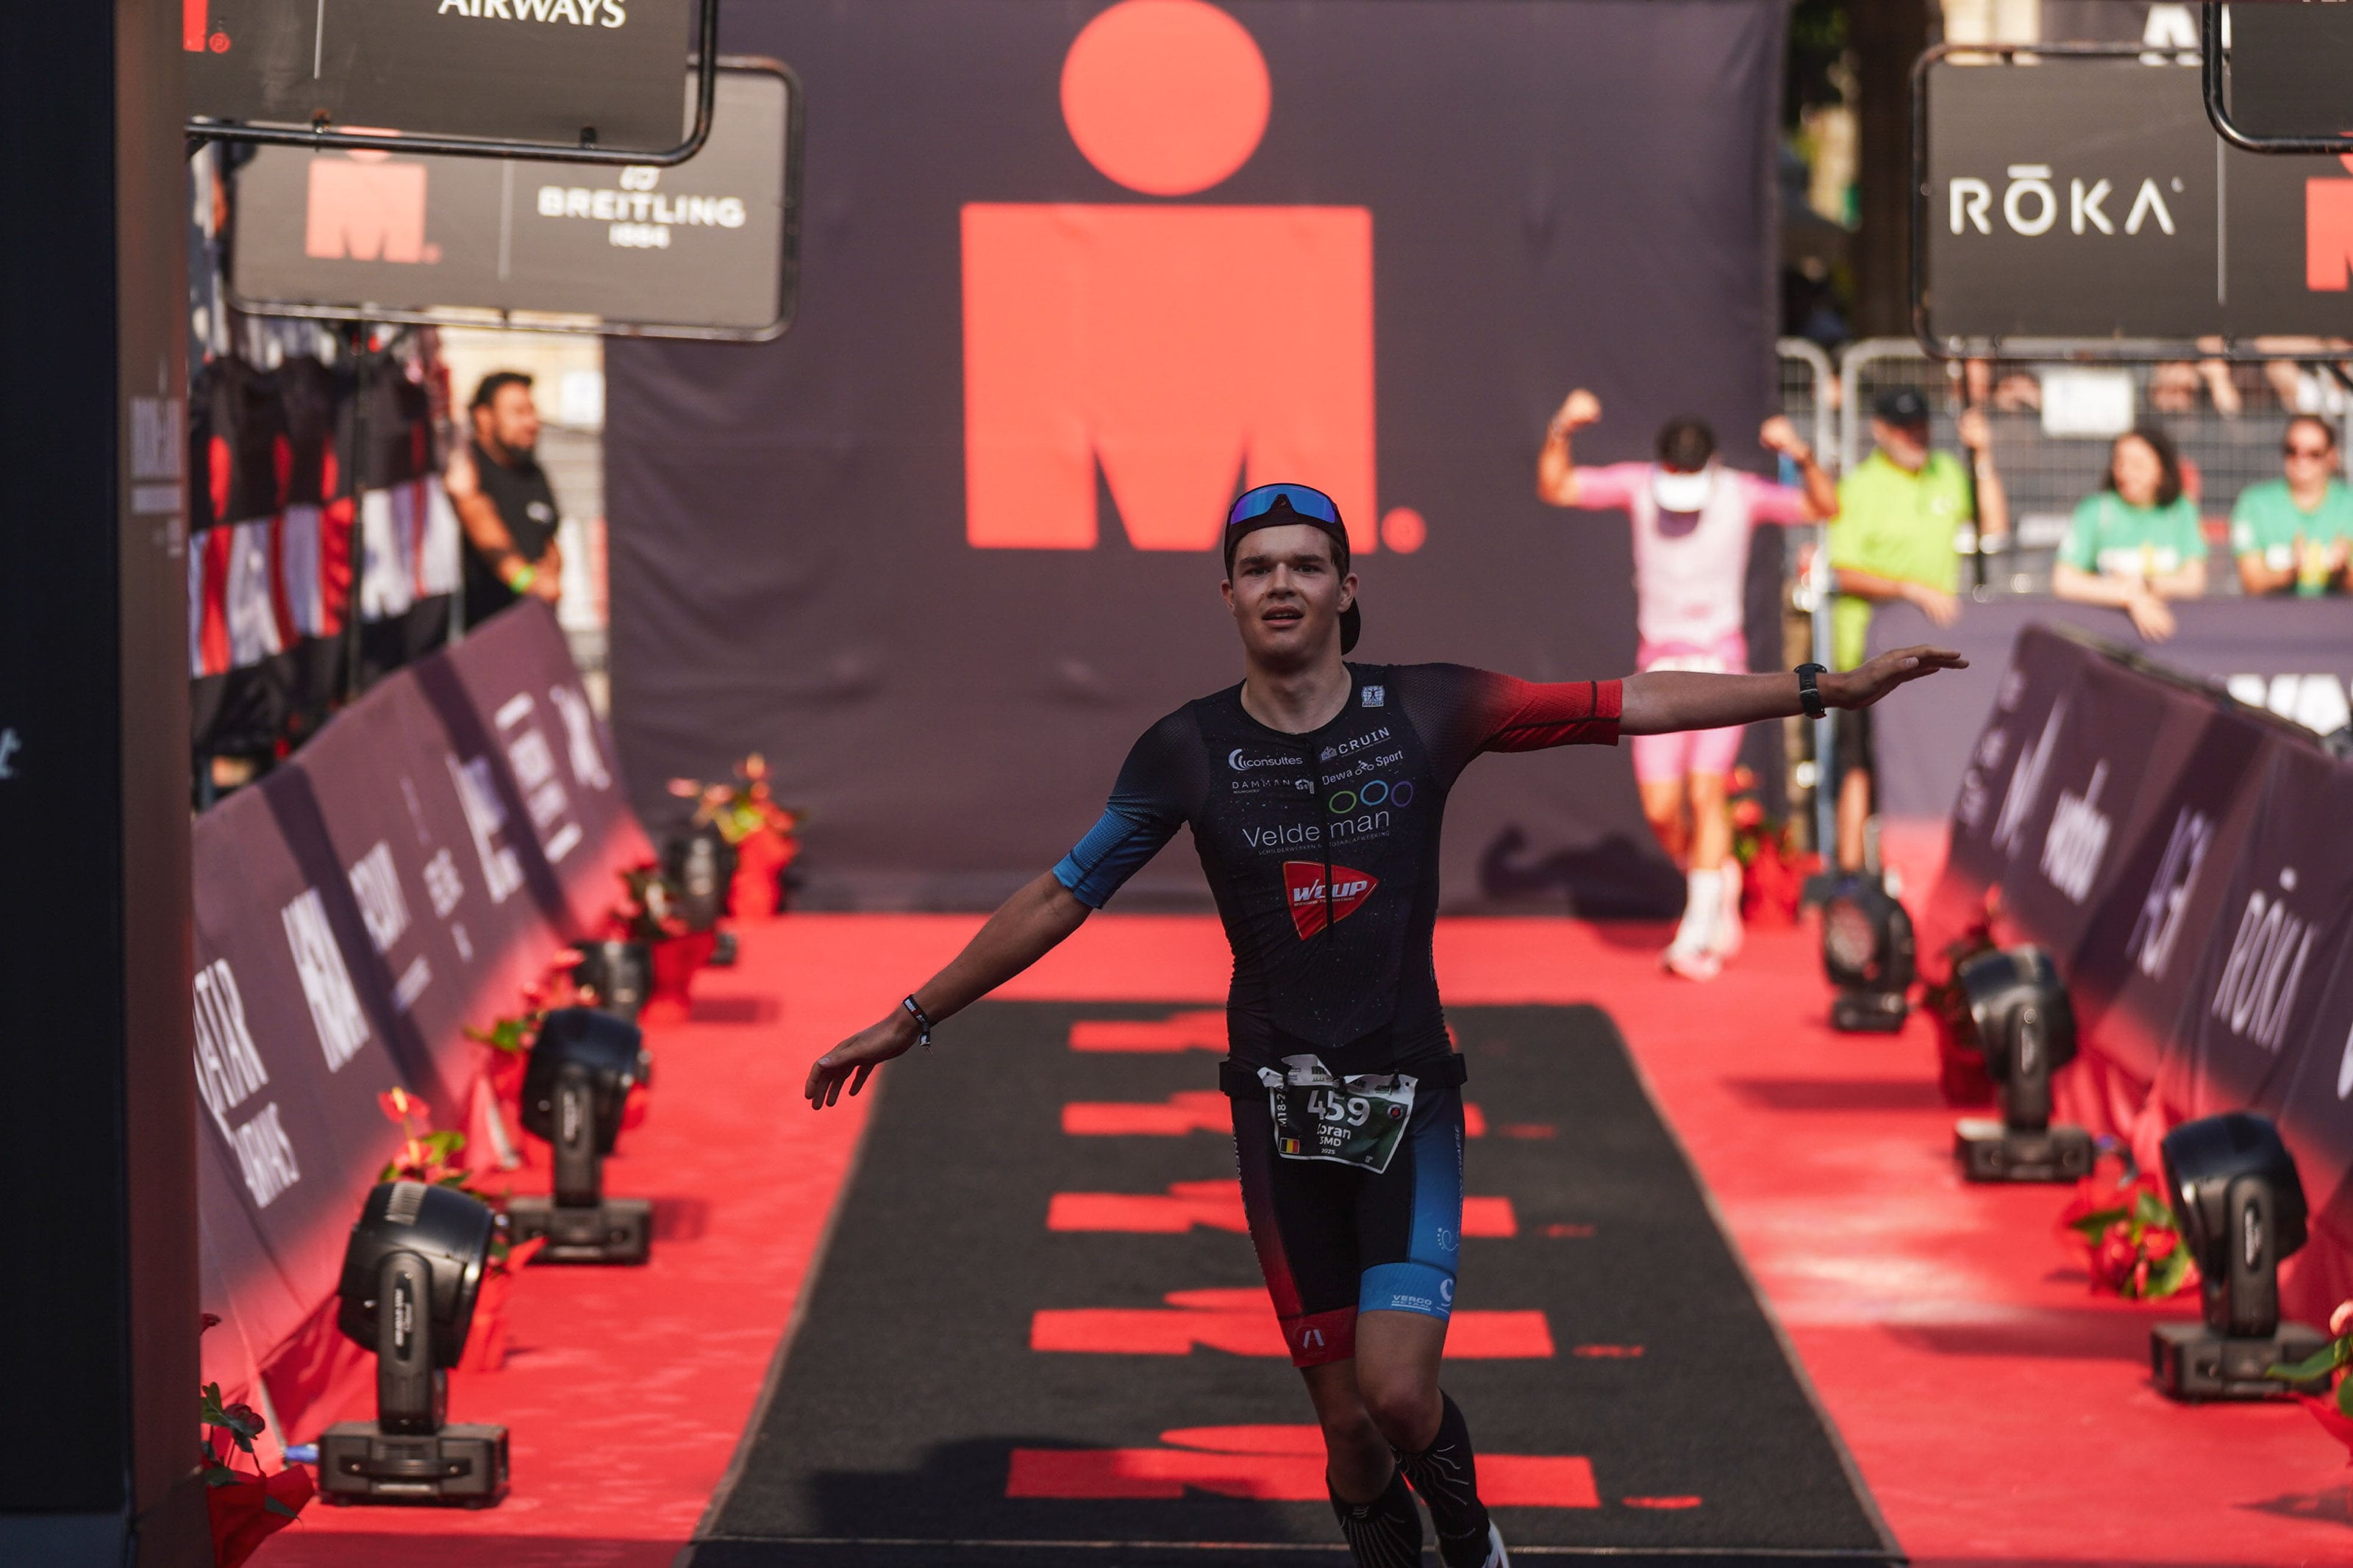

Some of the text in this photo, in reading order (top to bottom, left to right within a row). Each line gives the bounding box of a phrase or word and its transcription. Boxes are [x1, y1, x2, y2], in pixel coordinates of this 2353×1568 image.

[538, 185, 746, 228] BREITLING
[1338, 727, 1390, 754] CRUIN
[1232, 779, 1290, 789] DAMMAN
[1322, 750, 1403, 785] Dewa Sport
[1277, 1089, 1287, 1128] M18-2
[1307, 1089, 1370, 1127] 459
